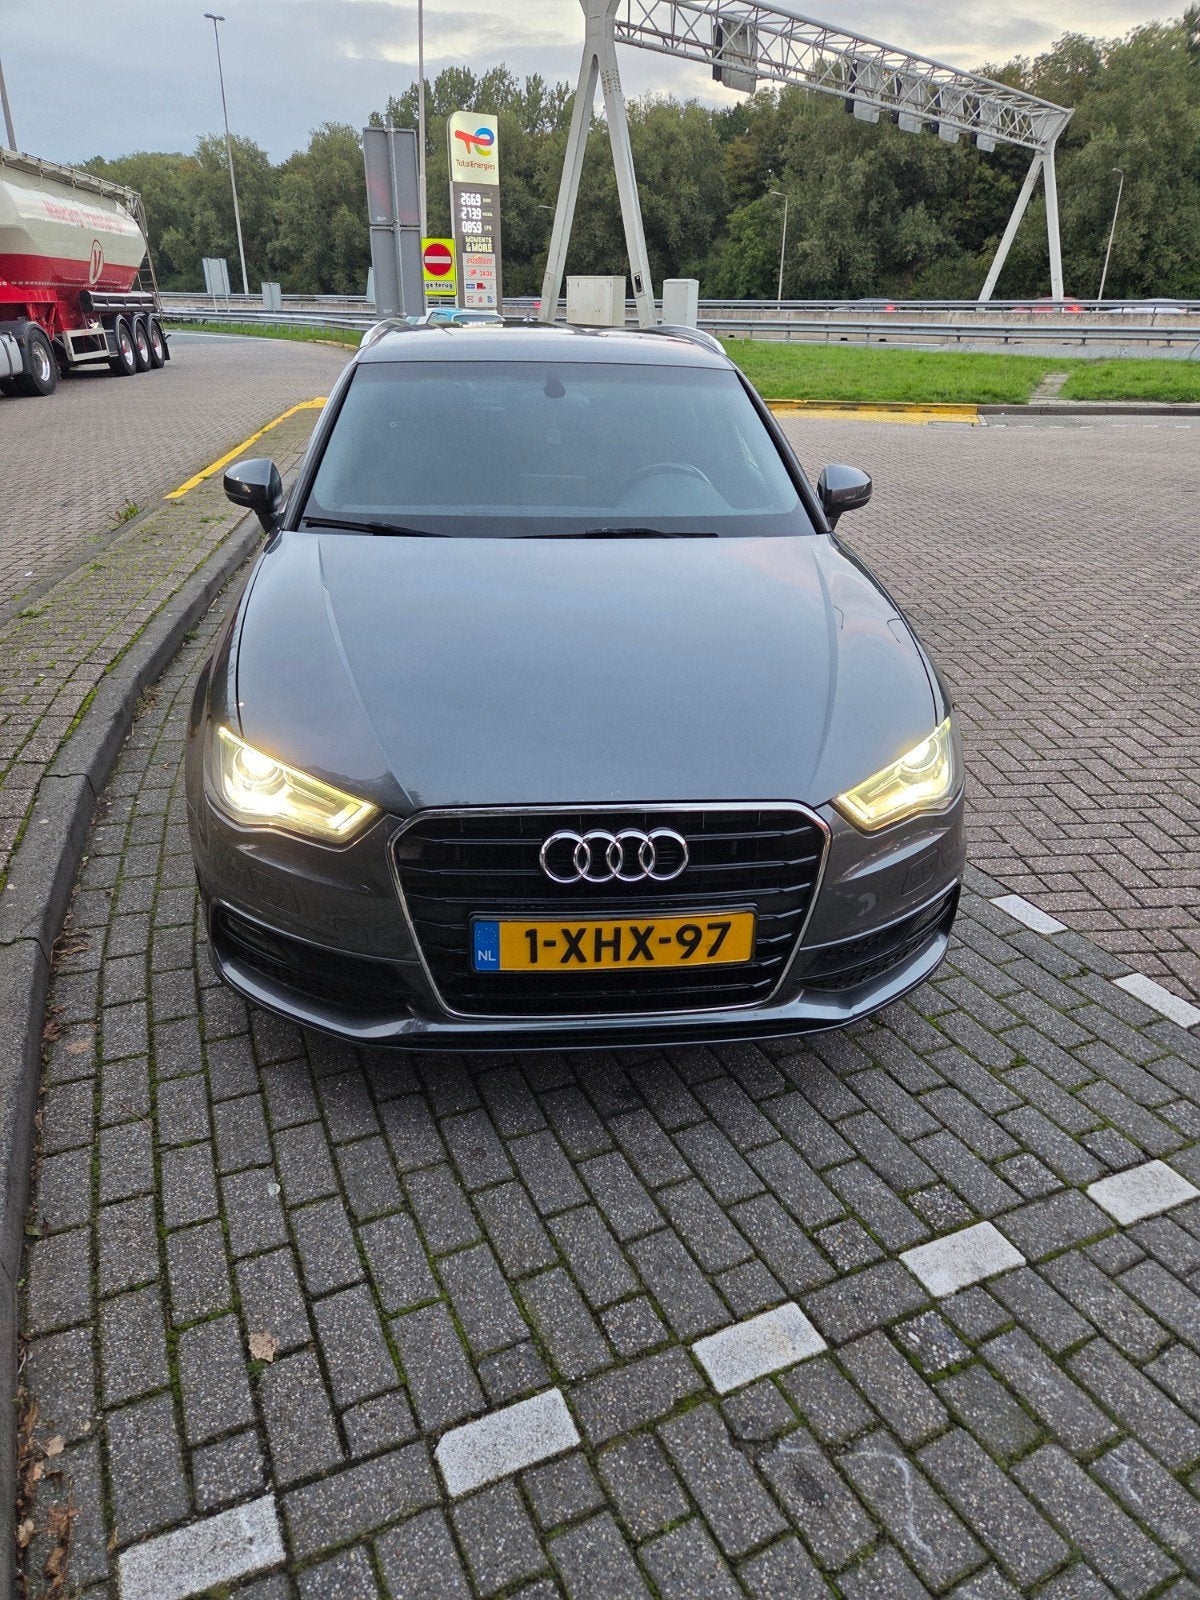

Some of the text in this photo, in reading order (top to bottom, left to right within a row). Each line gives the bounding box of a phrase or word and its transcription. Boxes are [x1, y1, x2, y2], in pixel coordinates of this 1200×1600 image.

[456, 159, 495, 171] TotalEnergies
[472, 243, 493, 252] MORE
[435, 282, 453, 290] terug
[525, 921, 732, 964] 1-XHX-97
[478, 951, 496, 961] NL
